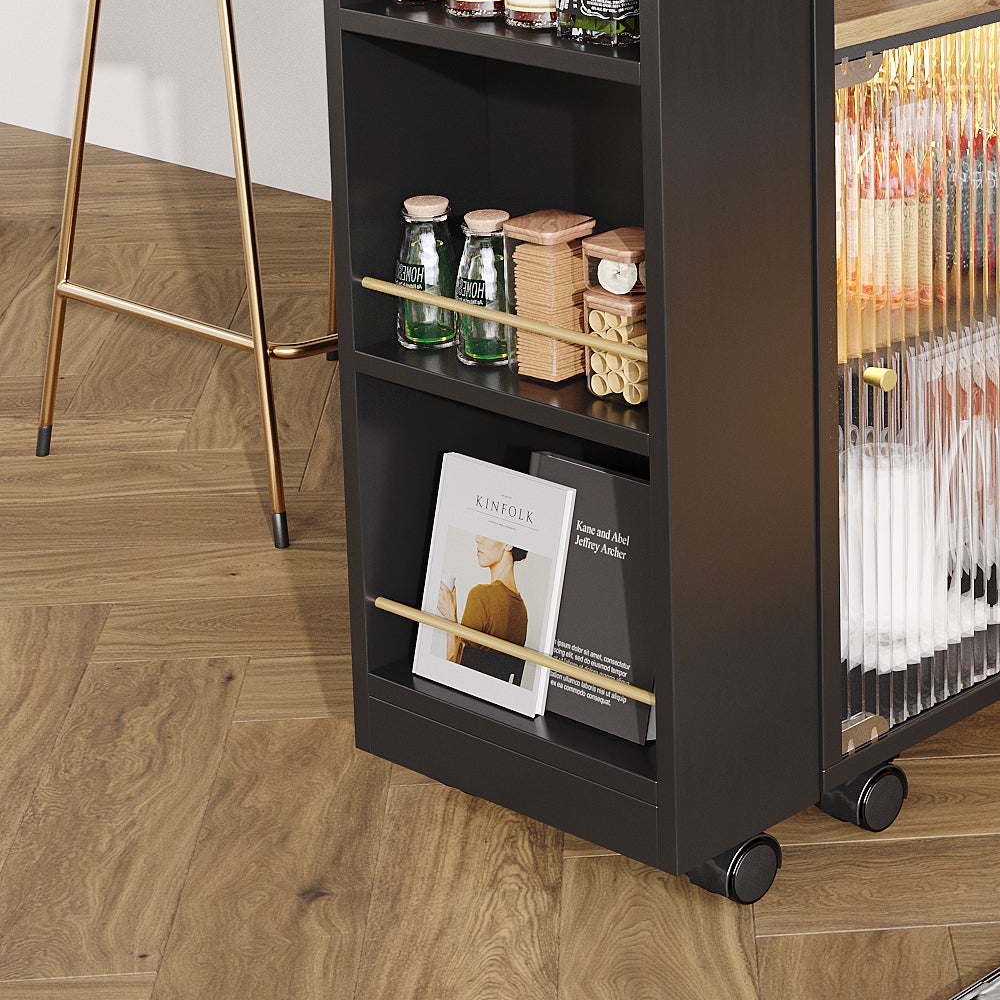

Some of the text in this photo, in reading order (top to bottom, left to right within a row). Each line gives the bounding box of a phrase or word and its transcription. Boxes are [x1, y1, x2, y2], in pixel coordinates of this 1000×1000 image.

[476, 495, 533, 524] KINFOLK
[576, 520, 630, 546] Kane and Abel
[575, 535, 626, 560] Jeffrey Archer
[557, 639, 571, 650] ipsum
[571, 644, 583, 654] dolor
[575, 654, 583, 662] sed
[611, 666, 628, 678] tempor
[564, 684, 586, 696] commodo
